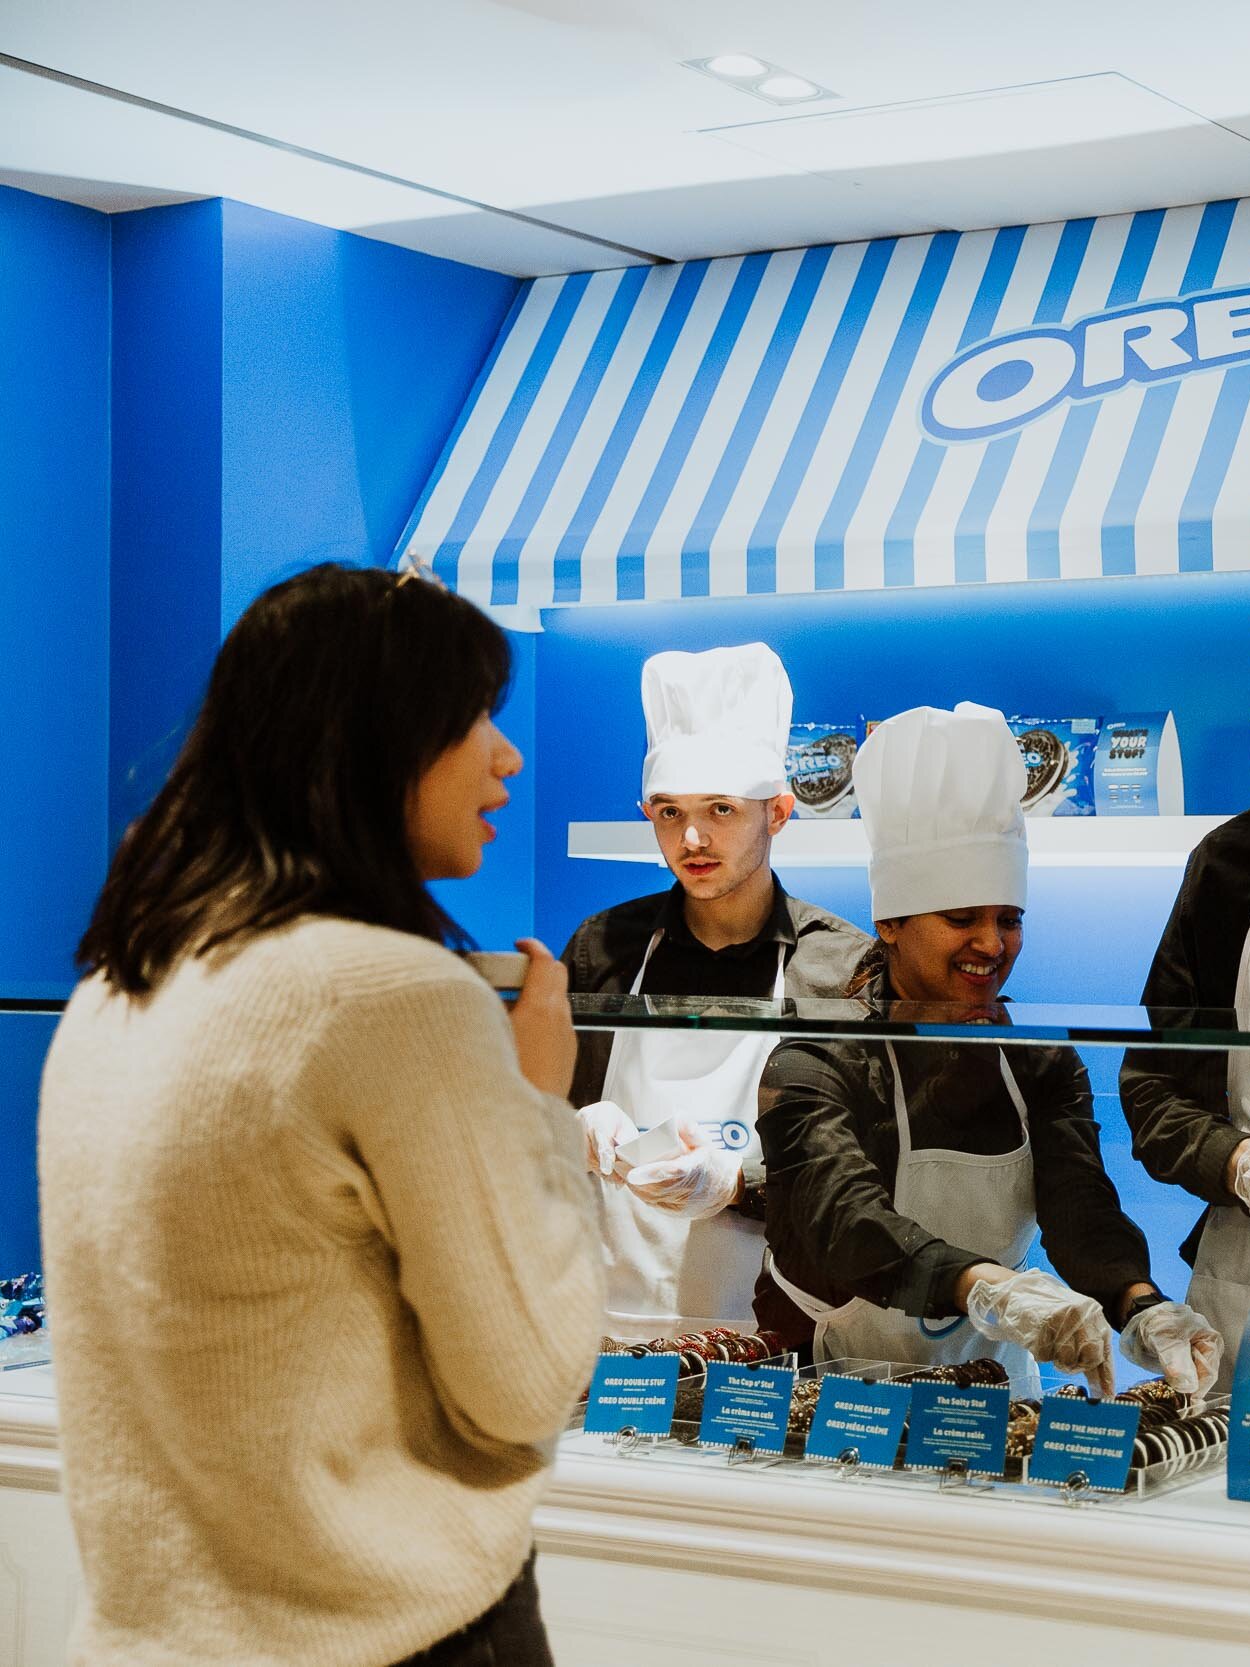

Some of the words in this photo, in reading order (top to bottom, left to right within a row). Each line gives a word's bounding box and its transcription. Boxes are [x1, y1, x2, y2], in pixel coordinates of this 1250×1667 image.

[1110, 736, 1147, 748] YOUR
[1109, 748, 1146, 760] STUF?
[604, 1377, 623, 1386] OREO
[623, 1378, 649, 1386] DOUBLE
[728, 1376, 740, 1385] The
[598, 1396, 617, 1404] OREO
[618, 1397, 644, 1405] DOUBLE
[937, 1396, 950, 1405] The
[950, 1397, 970, 1408] Salty
[834, 1401, 854, 1410] OREO
[854, 1404, 873, 1413] MEGA
[873, 1407, 891, 1416] STUF
[826, 1419, 845, 1429] OREO
[1049, 1421, 1071, 1431] OREO
[1071, 1424, 1086, 1434] THE
[1086, 1426, 1107, 1436] MOST
[1107, 1428, 1126, 1438] STUF
[933, 1427, 943, 1436] La
[1043, 1441, 1065, 1451] OREO
[1091, 1447, 1102, 1456] EN
[1102, 1448, 1124, 1458] FOLIE
